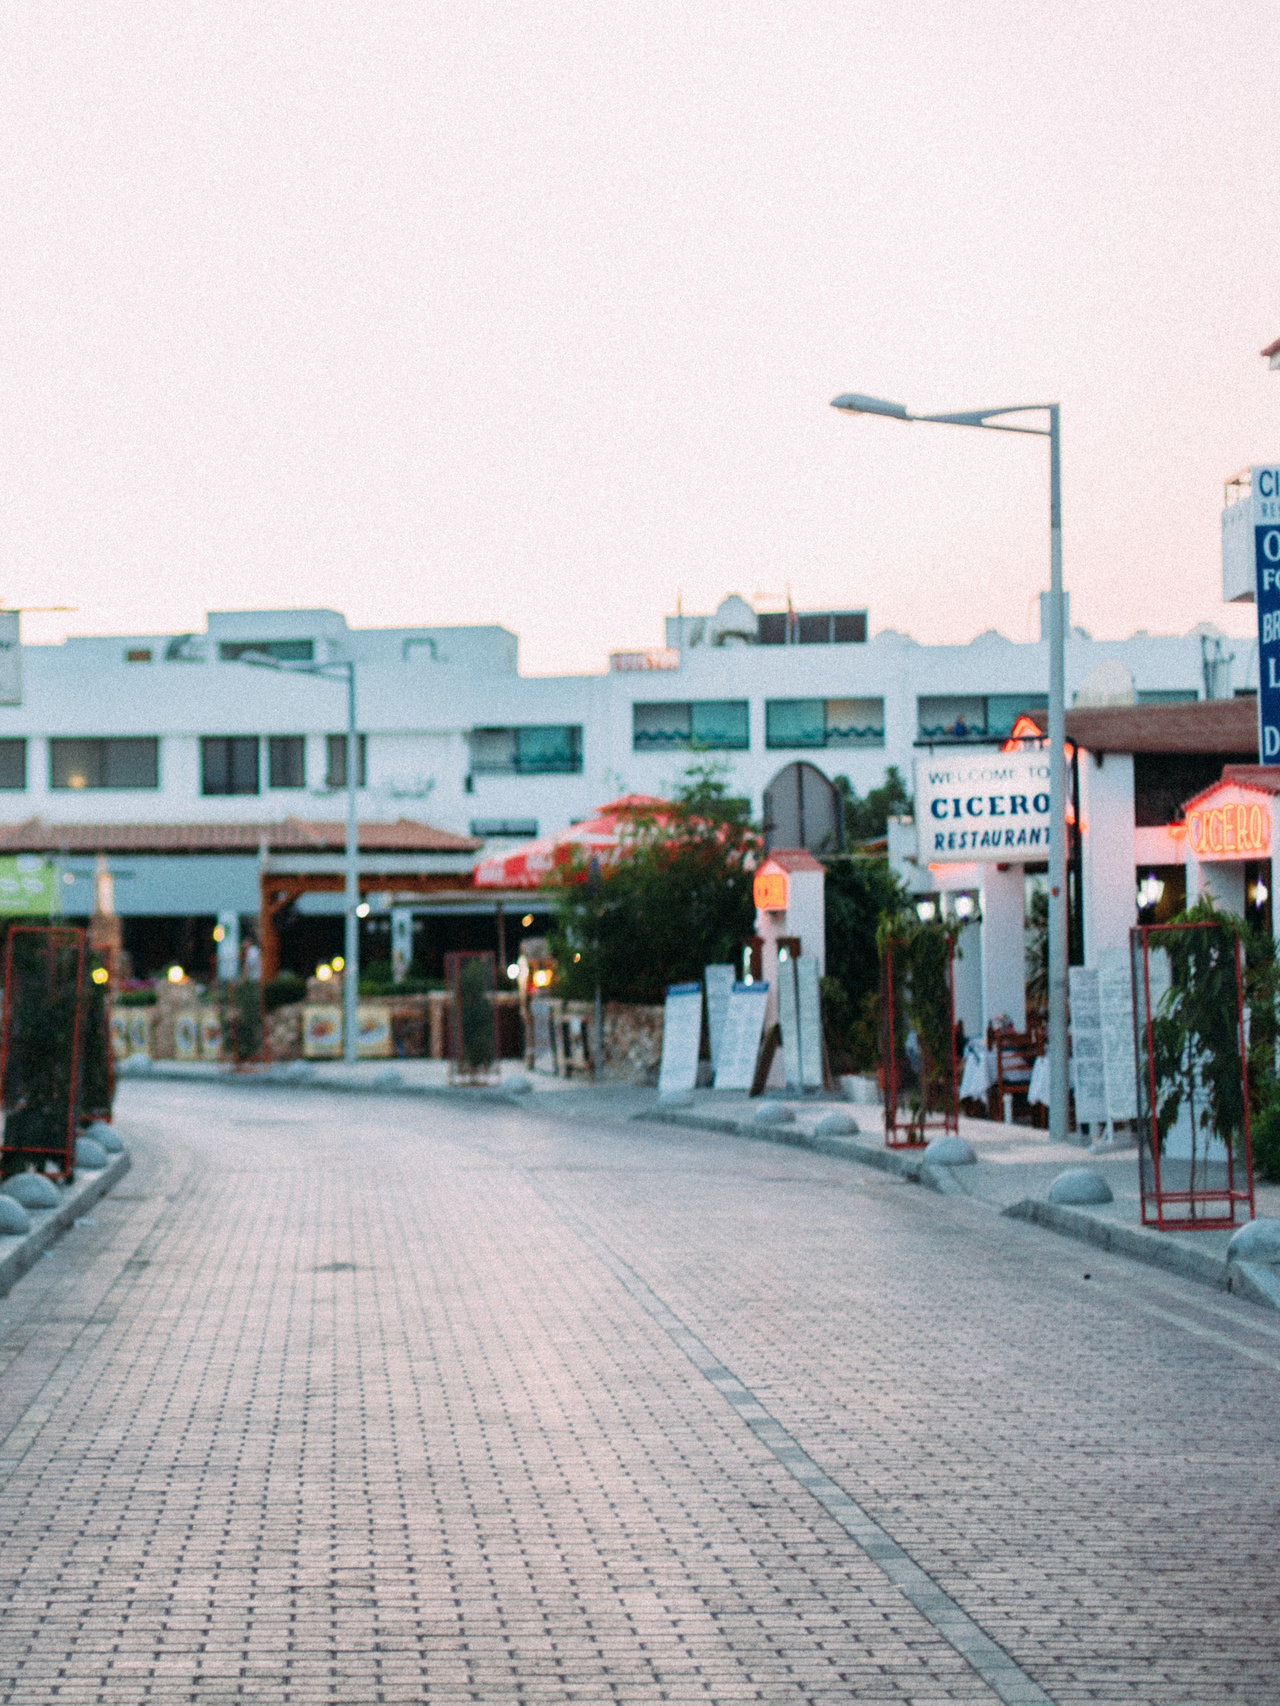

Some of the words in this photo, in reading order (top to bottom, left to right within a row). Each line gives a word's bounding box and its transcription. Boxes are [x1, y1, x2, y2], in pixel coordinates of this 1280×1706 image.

[928, 768, 1015, 786] WELCOME
[1029, 765, 1051, 780] TO
[930, 792, 1051, 820] CICERO
[934, 827, 1051, 851] RESTAURANT
[1187, 803, 1263, 855] CICERO
